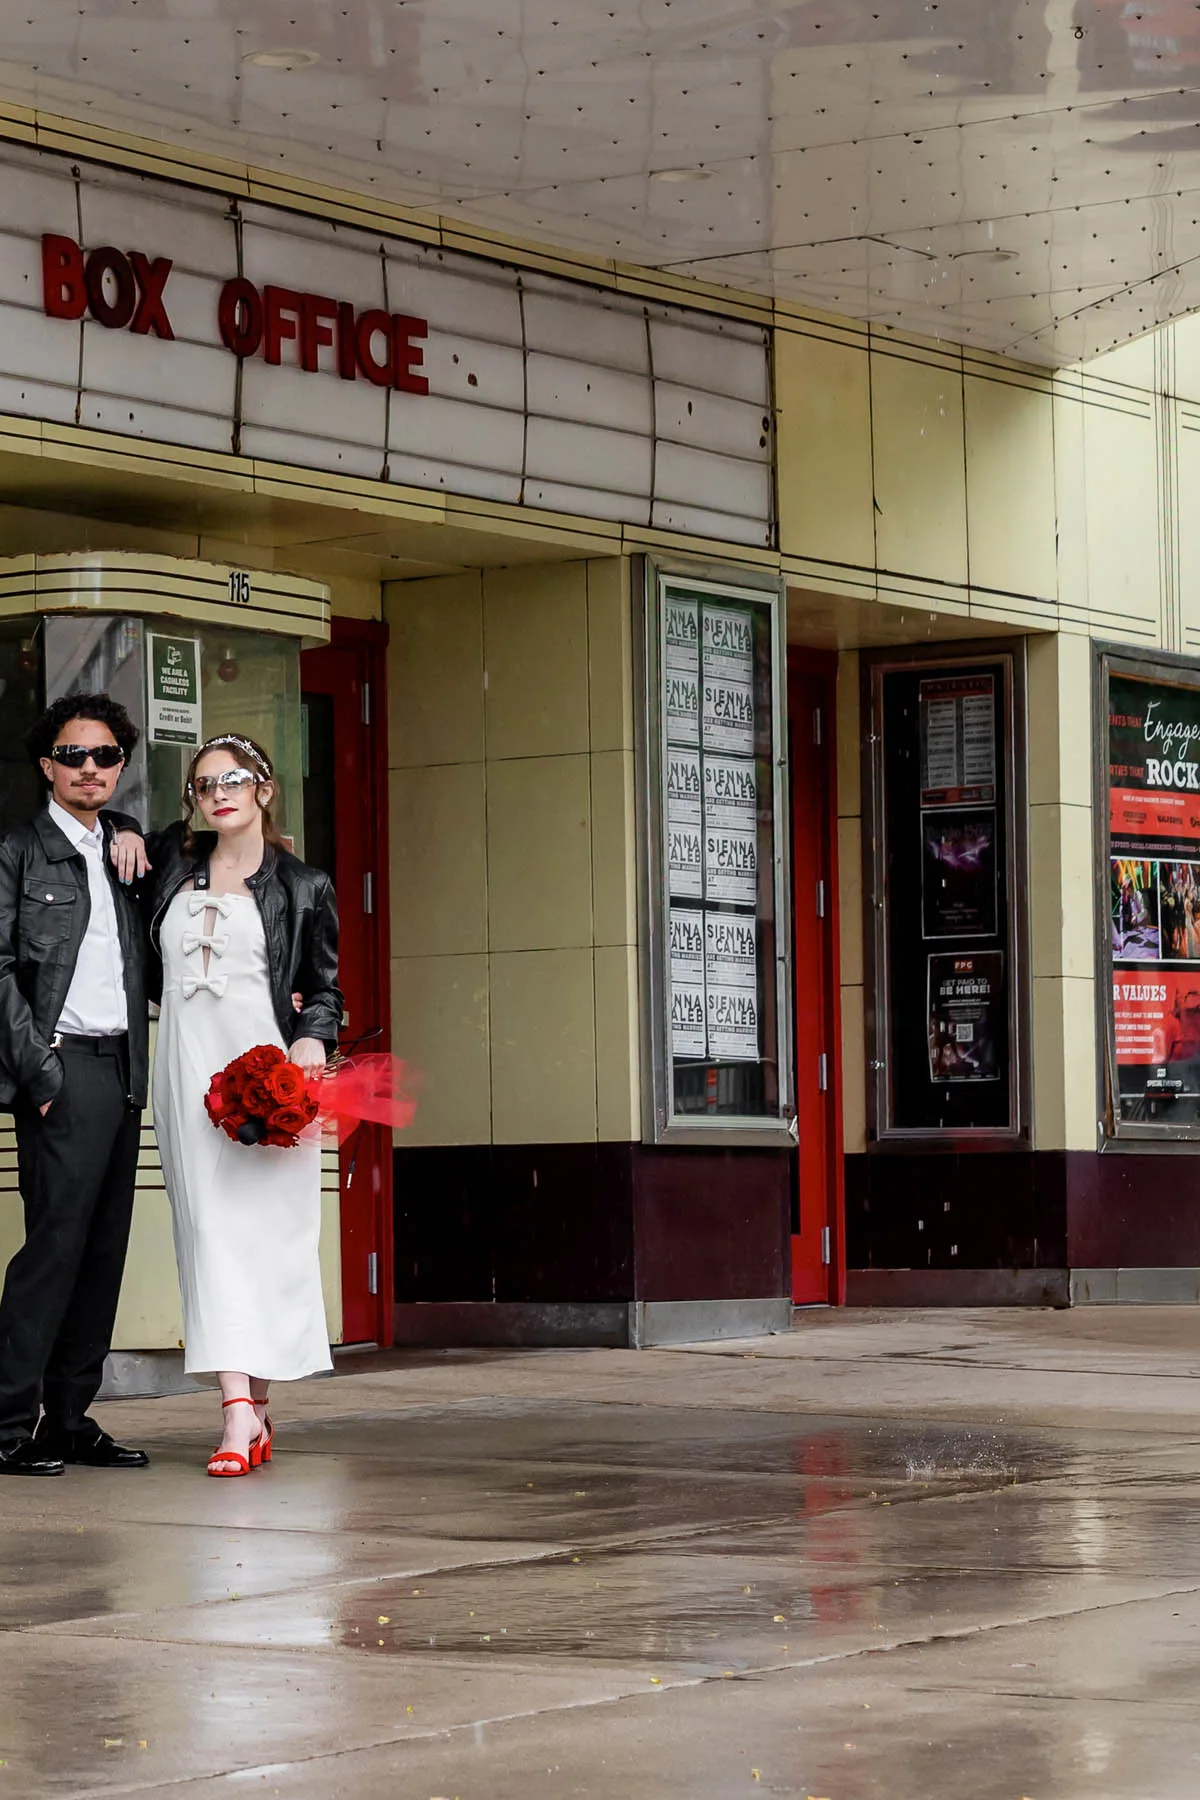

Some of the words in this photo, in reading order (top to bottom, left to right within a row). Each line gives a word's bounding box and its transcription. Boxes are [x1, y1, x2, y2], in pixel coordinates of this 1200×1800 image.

[42, 233, 175, 341] BOX
[218, 276, 430, 396] OFFICE
[229, 571, 249, 603] 115
[667, 621, 696, 640] ALEB
[704, 617, 750, 639] SIENNA
[712, 632, 752, 651] CALEB
[161, 667, 170, 675] WE
[172, 668, 183, 676] ARE
[160, 676, 189, 687] CASHLESS
[163, 686, 187, 696] FACILITY
[705, 688, 751, 707] SIENNA
[669, 693, 697, 710] ALEB
[715, 702, 752, 721] CALEB
[668, 776, 699, 792] ALEB
[706, 768, 753, 785] SIENNA
[715, 782, 755, 799] CALEB
[671, 847, 700, 862] ALEB
[708, 838, 754, 857] SIENNA
[718, 852, 755, 869] CALEB
[707, 924, 754, 942] SIENNA
[671, 935, 701, 951] ALEB
[716, 939, 754, 955] CALEB
[940, 986, 953, 995] BE
[956, 984, 991, 995] HERE!
[1122, 985, 1166, 1001] VALUES
[709, 995, 754, 1012] SIENNA
[672, 1007, 702, 1022] ALEB
[716, 1009, 756, 1025] CALEB
